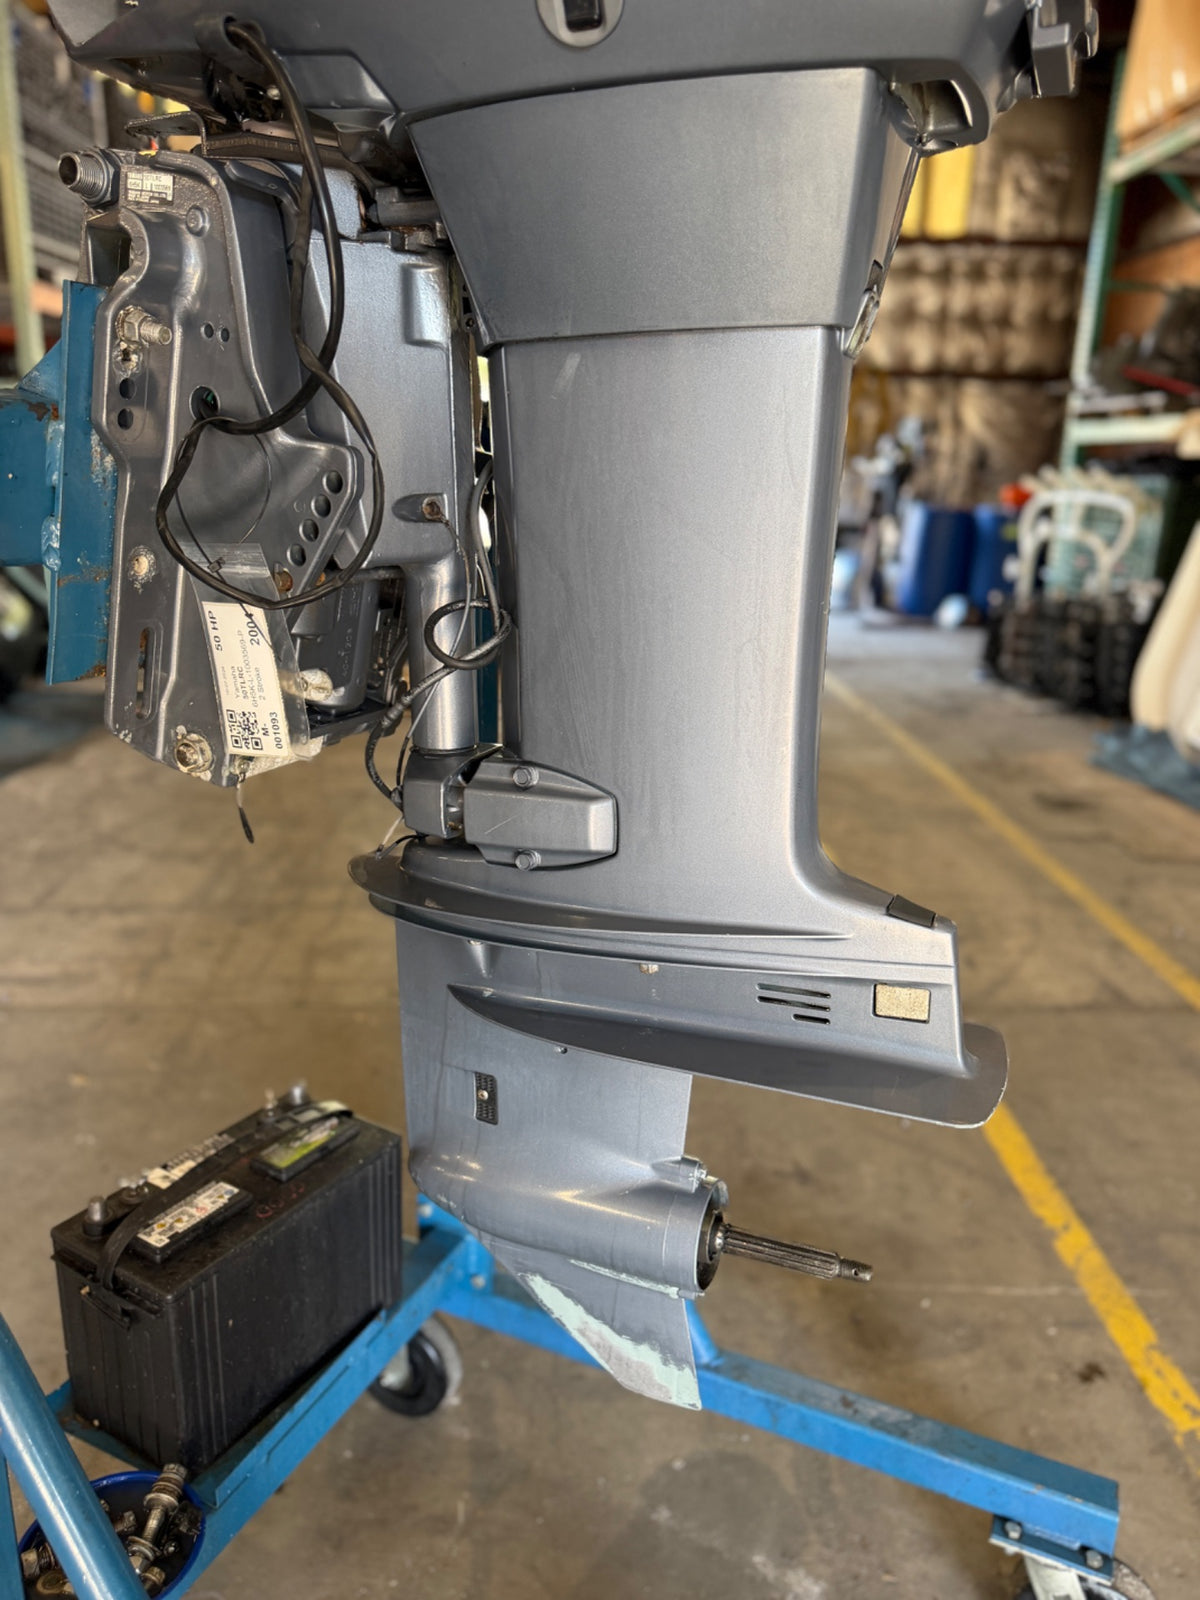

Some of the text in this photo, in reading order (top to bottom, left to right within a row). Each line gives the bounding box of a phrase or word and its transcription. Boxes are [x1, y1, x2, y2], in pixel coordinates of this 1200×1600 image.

[207, 610, 223, 651] 50 HP
[230, 666, 239, 699] Yamaha
[237, 666, 249, 700] 50TLRC
[254, 667, 264, 694] Stroke
[269, 711, 283, 749] 001093
